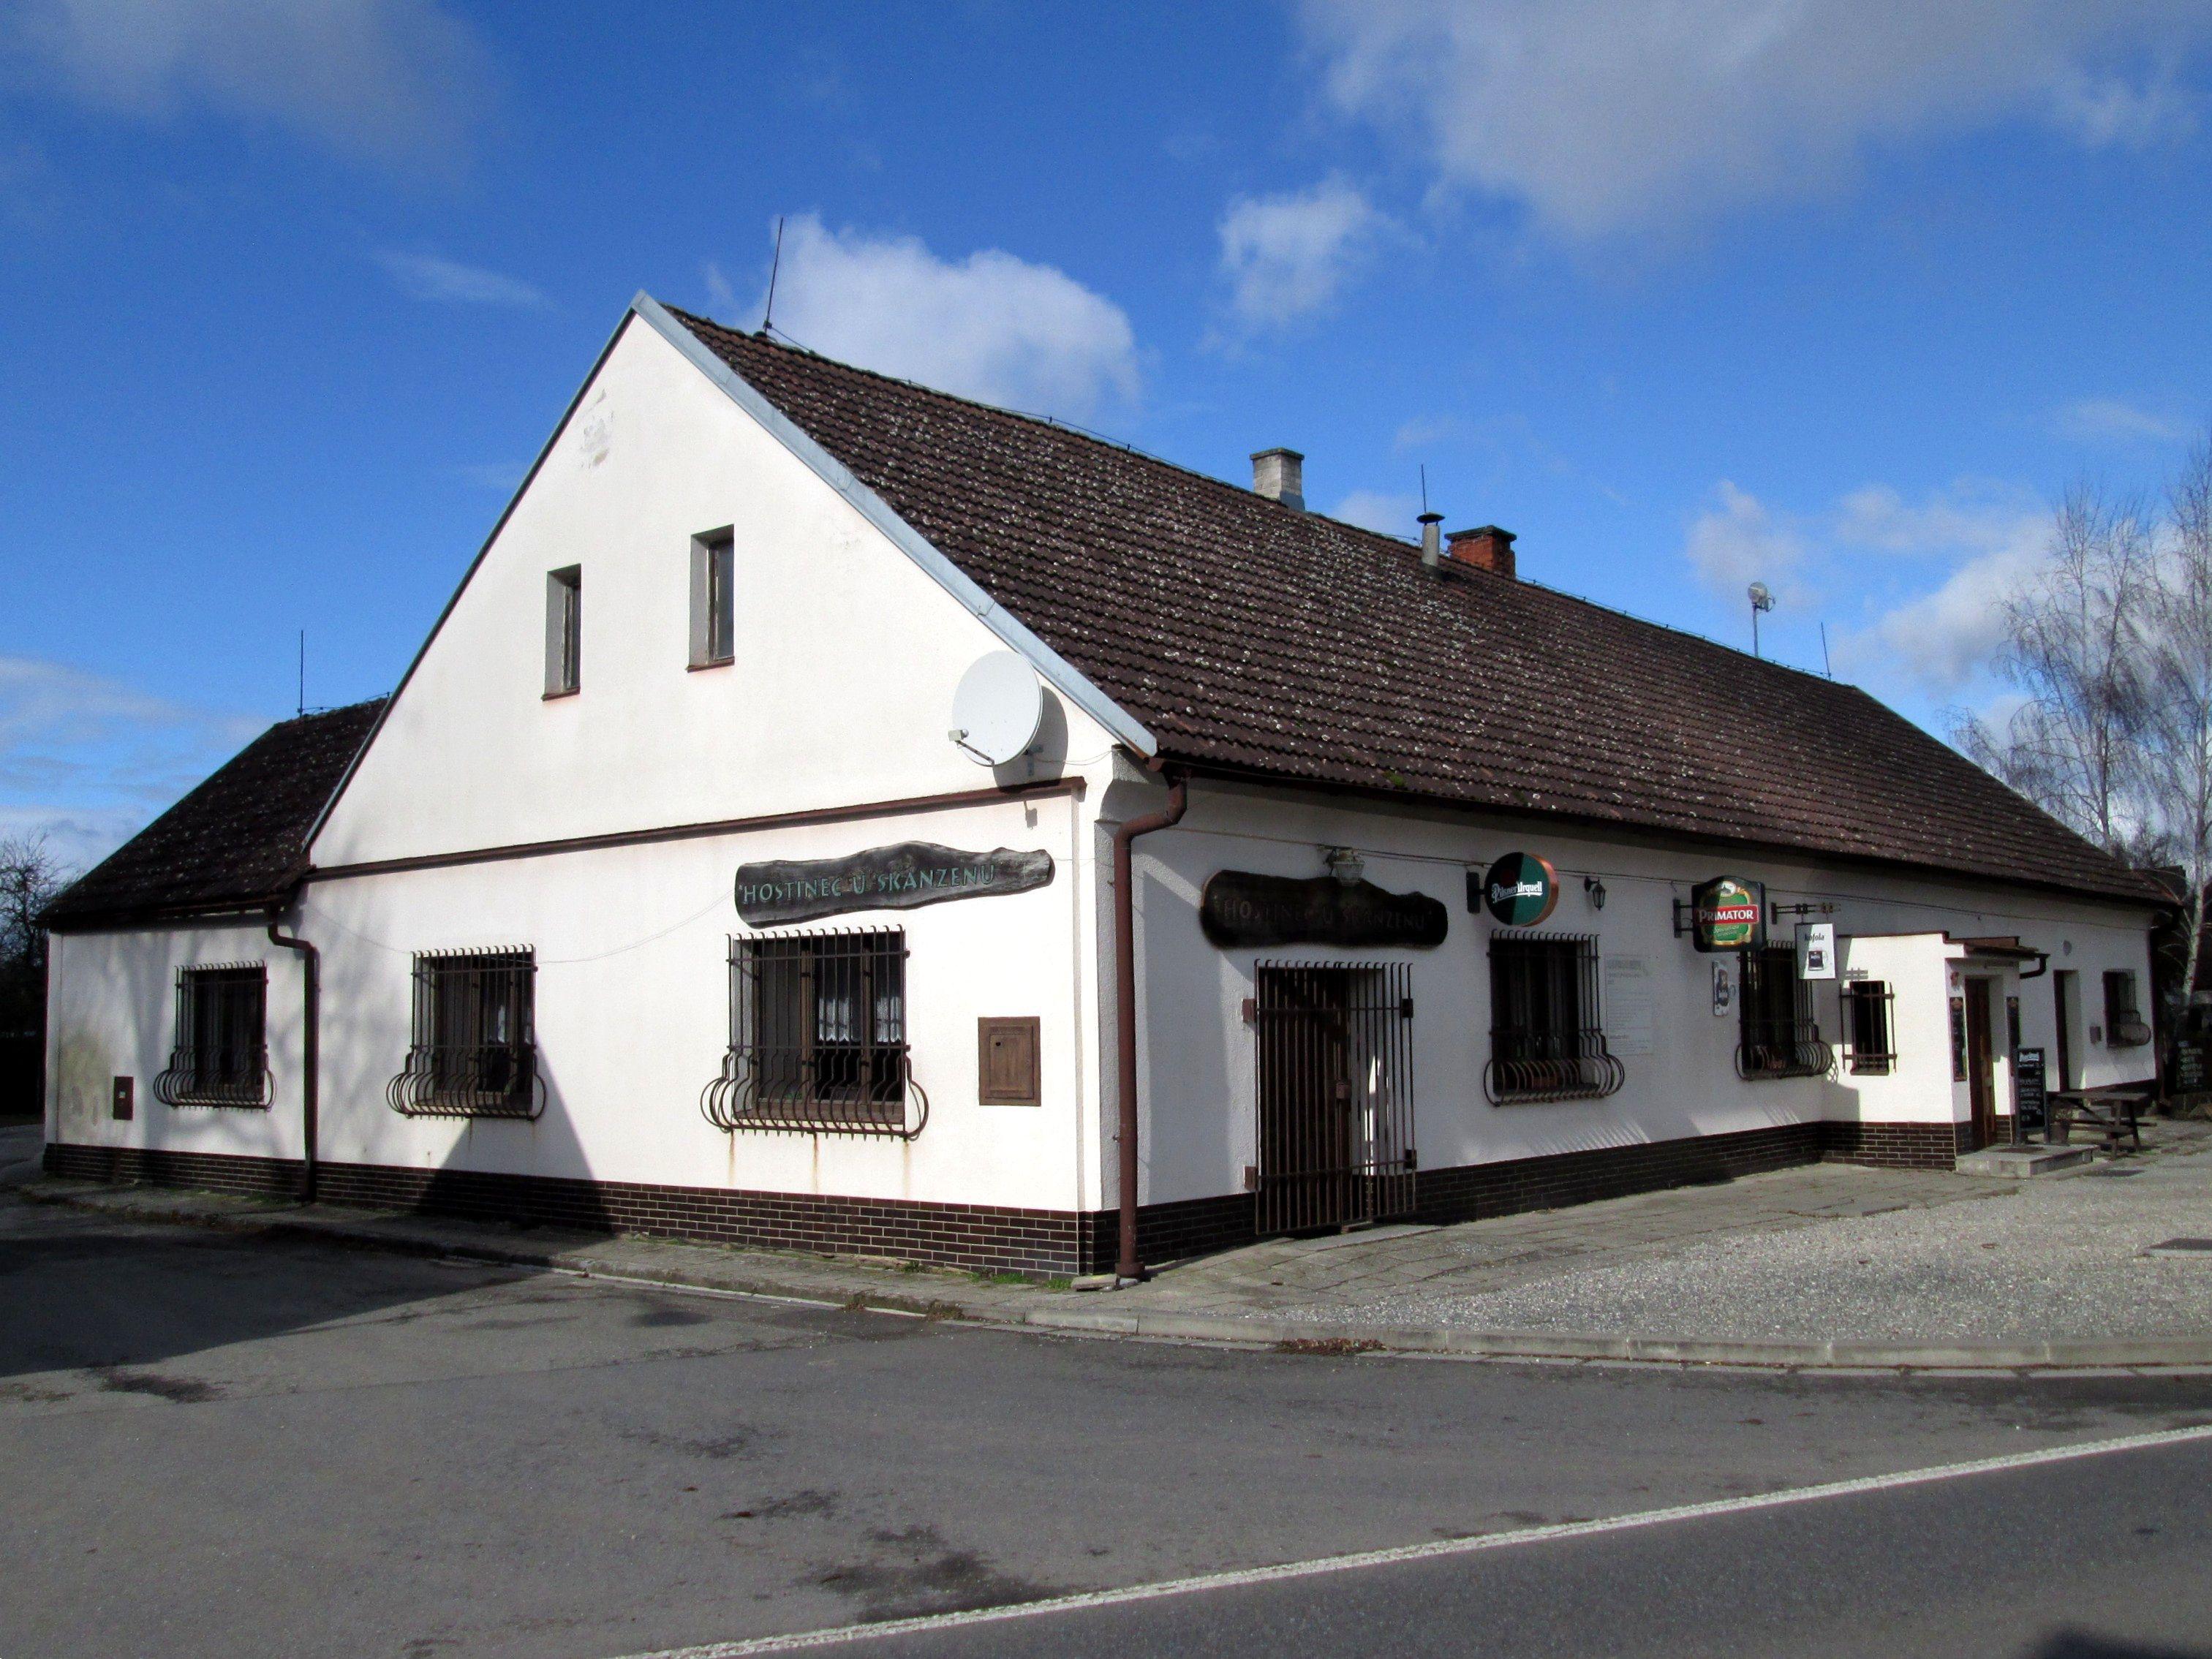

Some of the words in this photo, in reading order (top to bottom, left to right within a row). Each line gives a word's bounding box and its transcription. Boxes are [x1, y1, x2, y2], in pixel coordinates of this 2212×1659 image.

[742, 877, 843, 904] HOSTINEC
[853, 874, 867, 894] U
[877, 864, 995, 893] SKANZENU
[1492, 883, 1517, 904] Pilsner
[1517, 880, 1542, 897] Urquell
